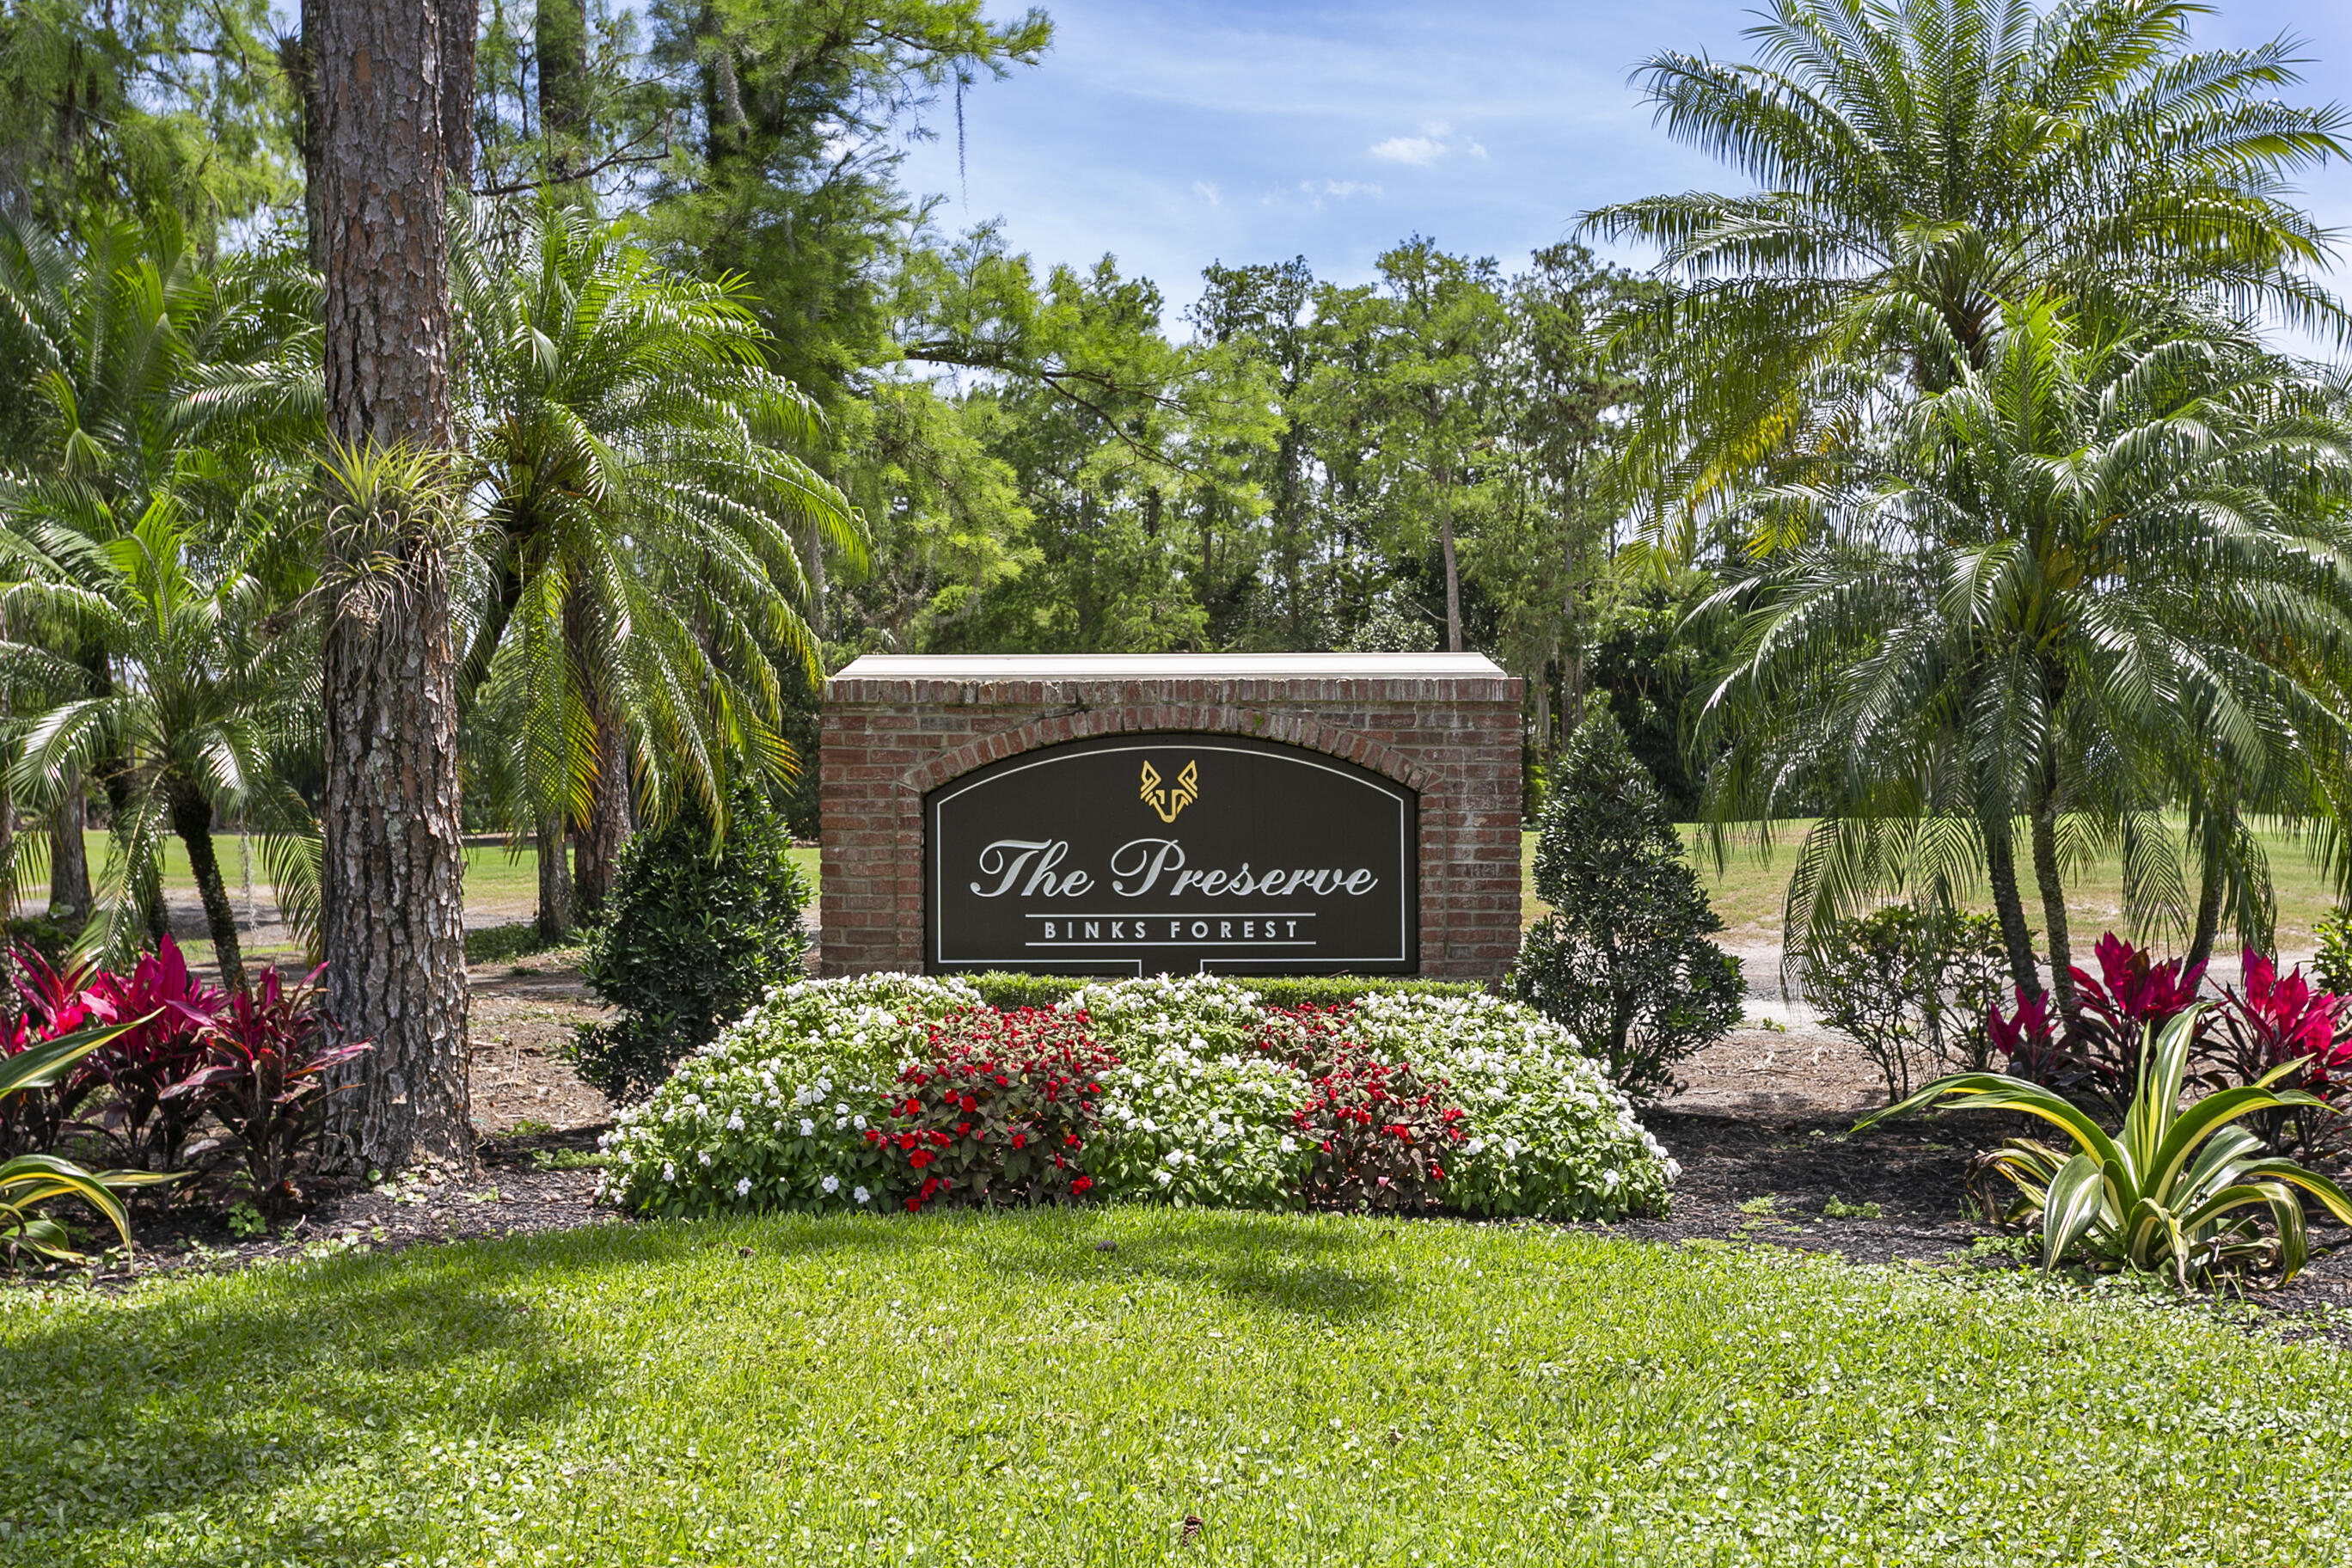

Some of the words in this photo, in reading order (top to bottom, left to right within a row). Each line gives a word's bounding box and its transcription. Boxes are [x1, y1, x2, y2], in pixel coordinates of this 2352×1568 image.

[970, 838, 1095, 897] The
[1111, 837, 1379, 897] Preserve
[1044, 921, 1146, 939] BINKS
[1170, 921, 1297, 939] FOREST
